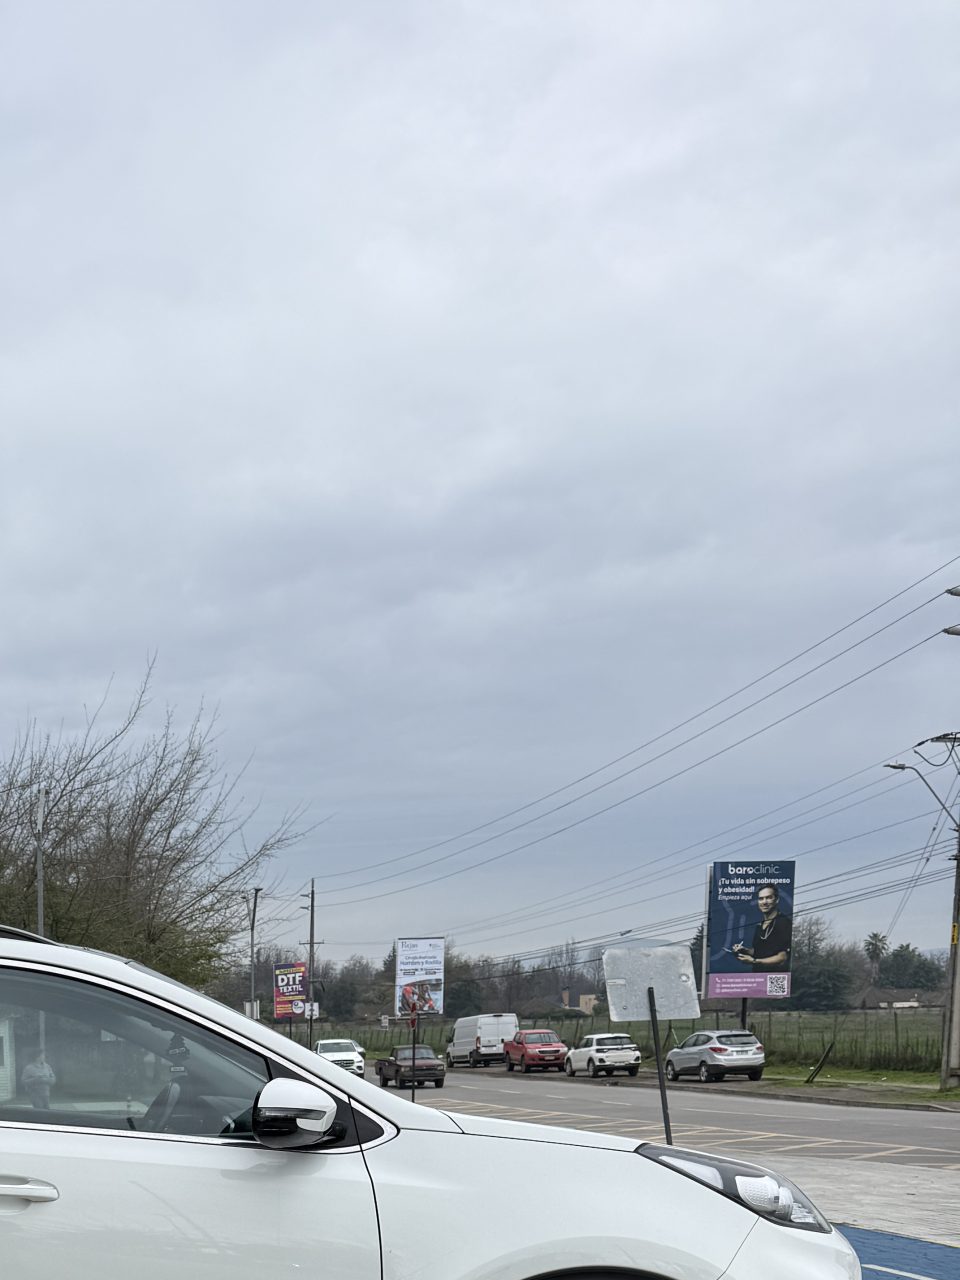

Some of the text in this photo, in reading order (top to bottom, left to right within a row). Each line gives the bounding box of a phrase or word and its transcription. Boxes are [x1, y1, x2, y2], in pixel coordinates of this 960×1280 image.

[728, 864, 779, 874] baroclinic
[757, 877, 790, 885] sobrepeso
[278, 973, 303, 986] DTF
[279, 984, 303, 993] TEXTIL
